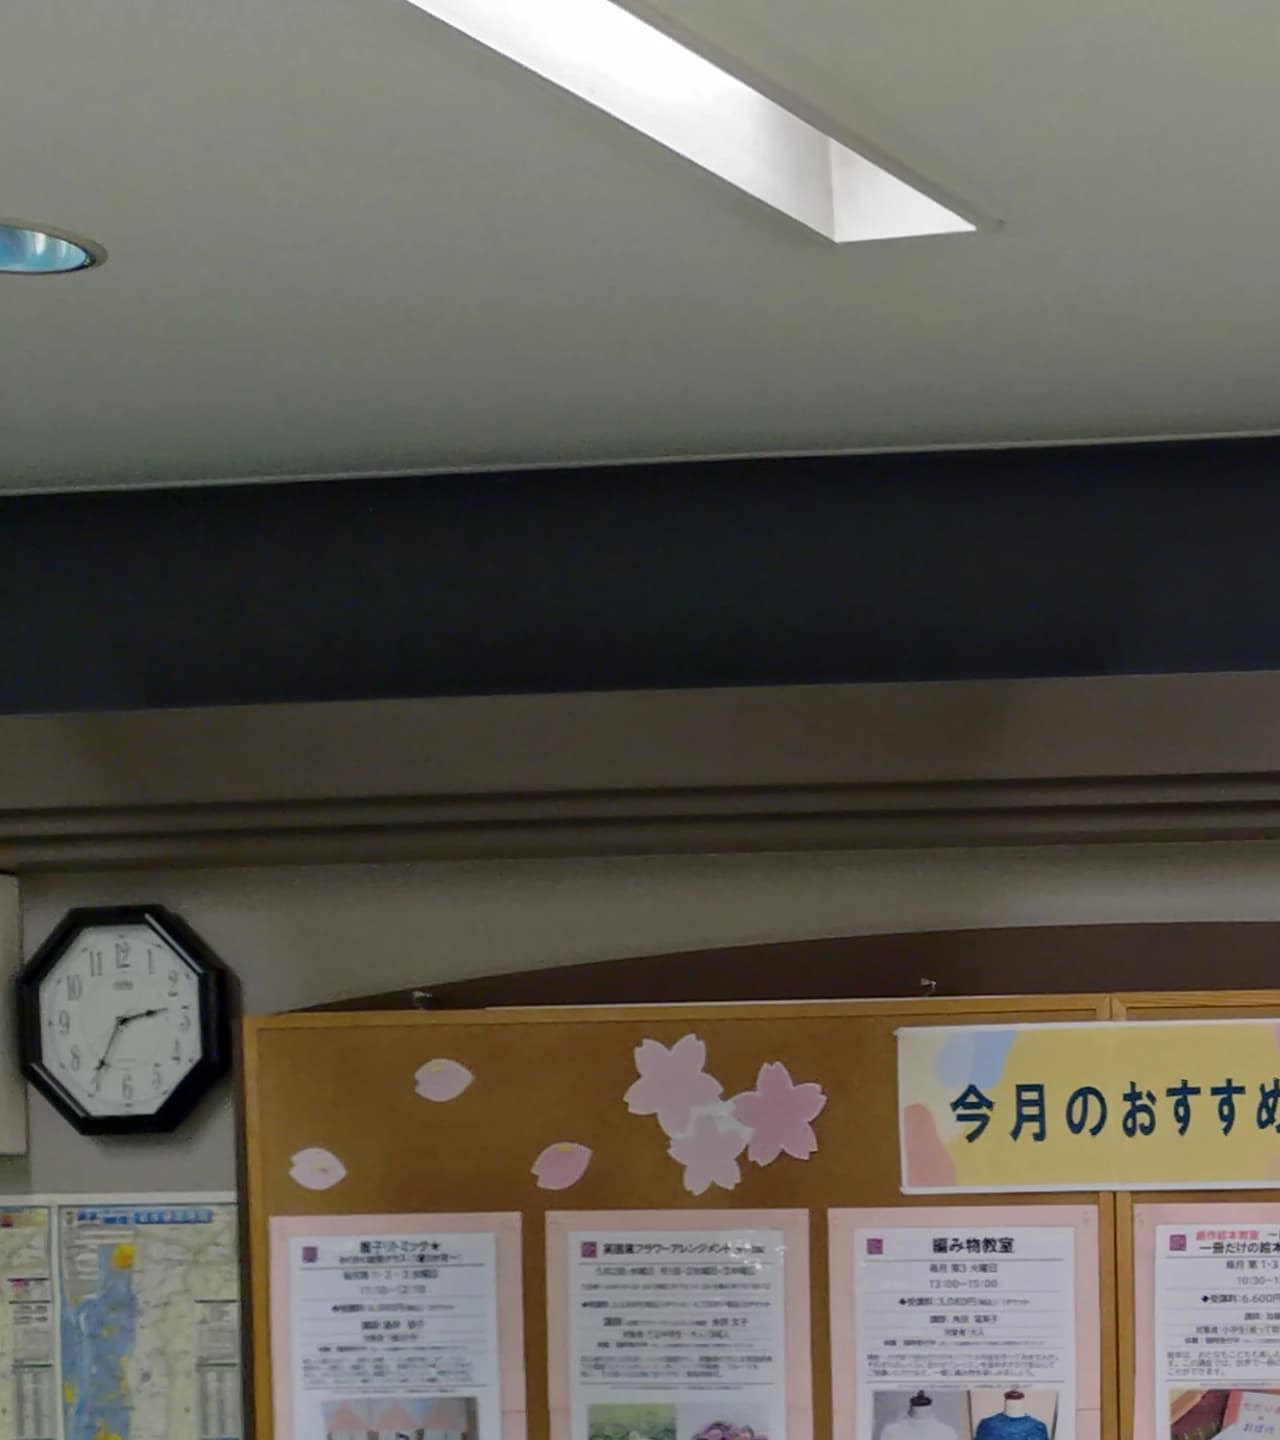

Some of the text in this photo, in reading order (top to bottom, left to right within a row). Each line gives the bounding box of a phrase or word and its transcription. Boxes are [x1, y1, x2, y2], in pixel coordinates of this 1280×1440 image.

[932, 1236, 1016, 1254] 編み物教室
